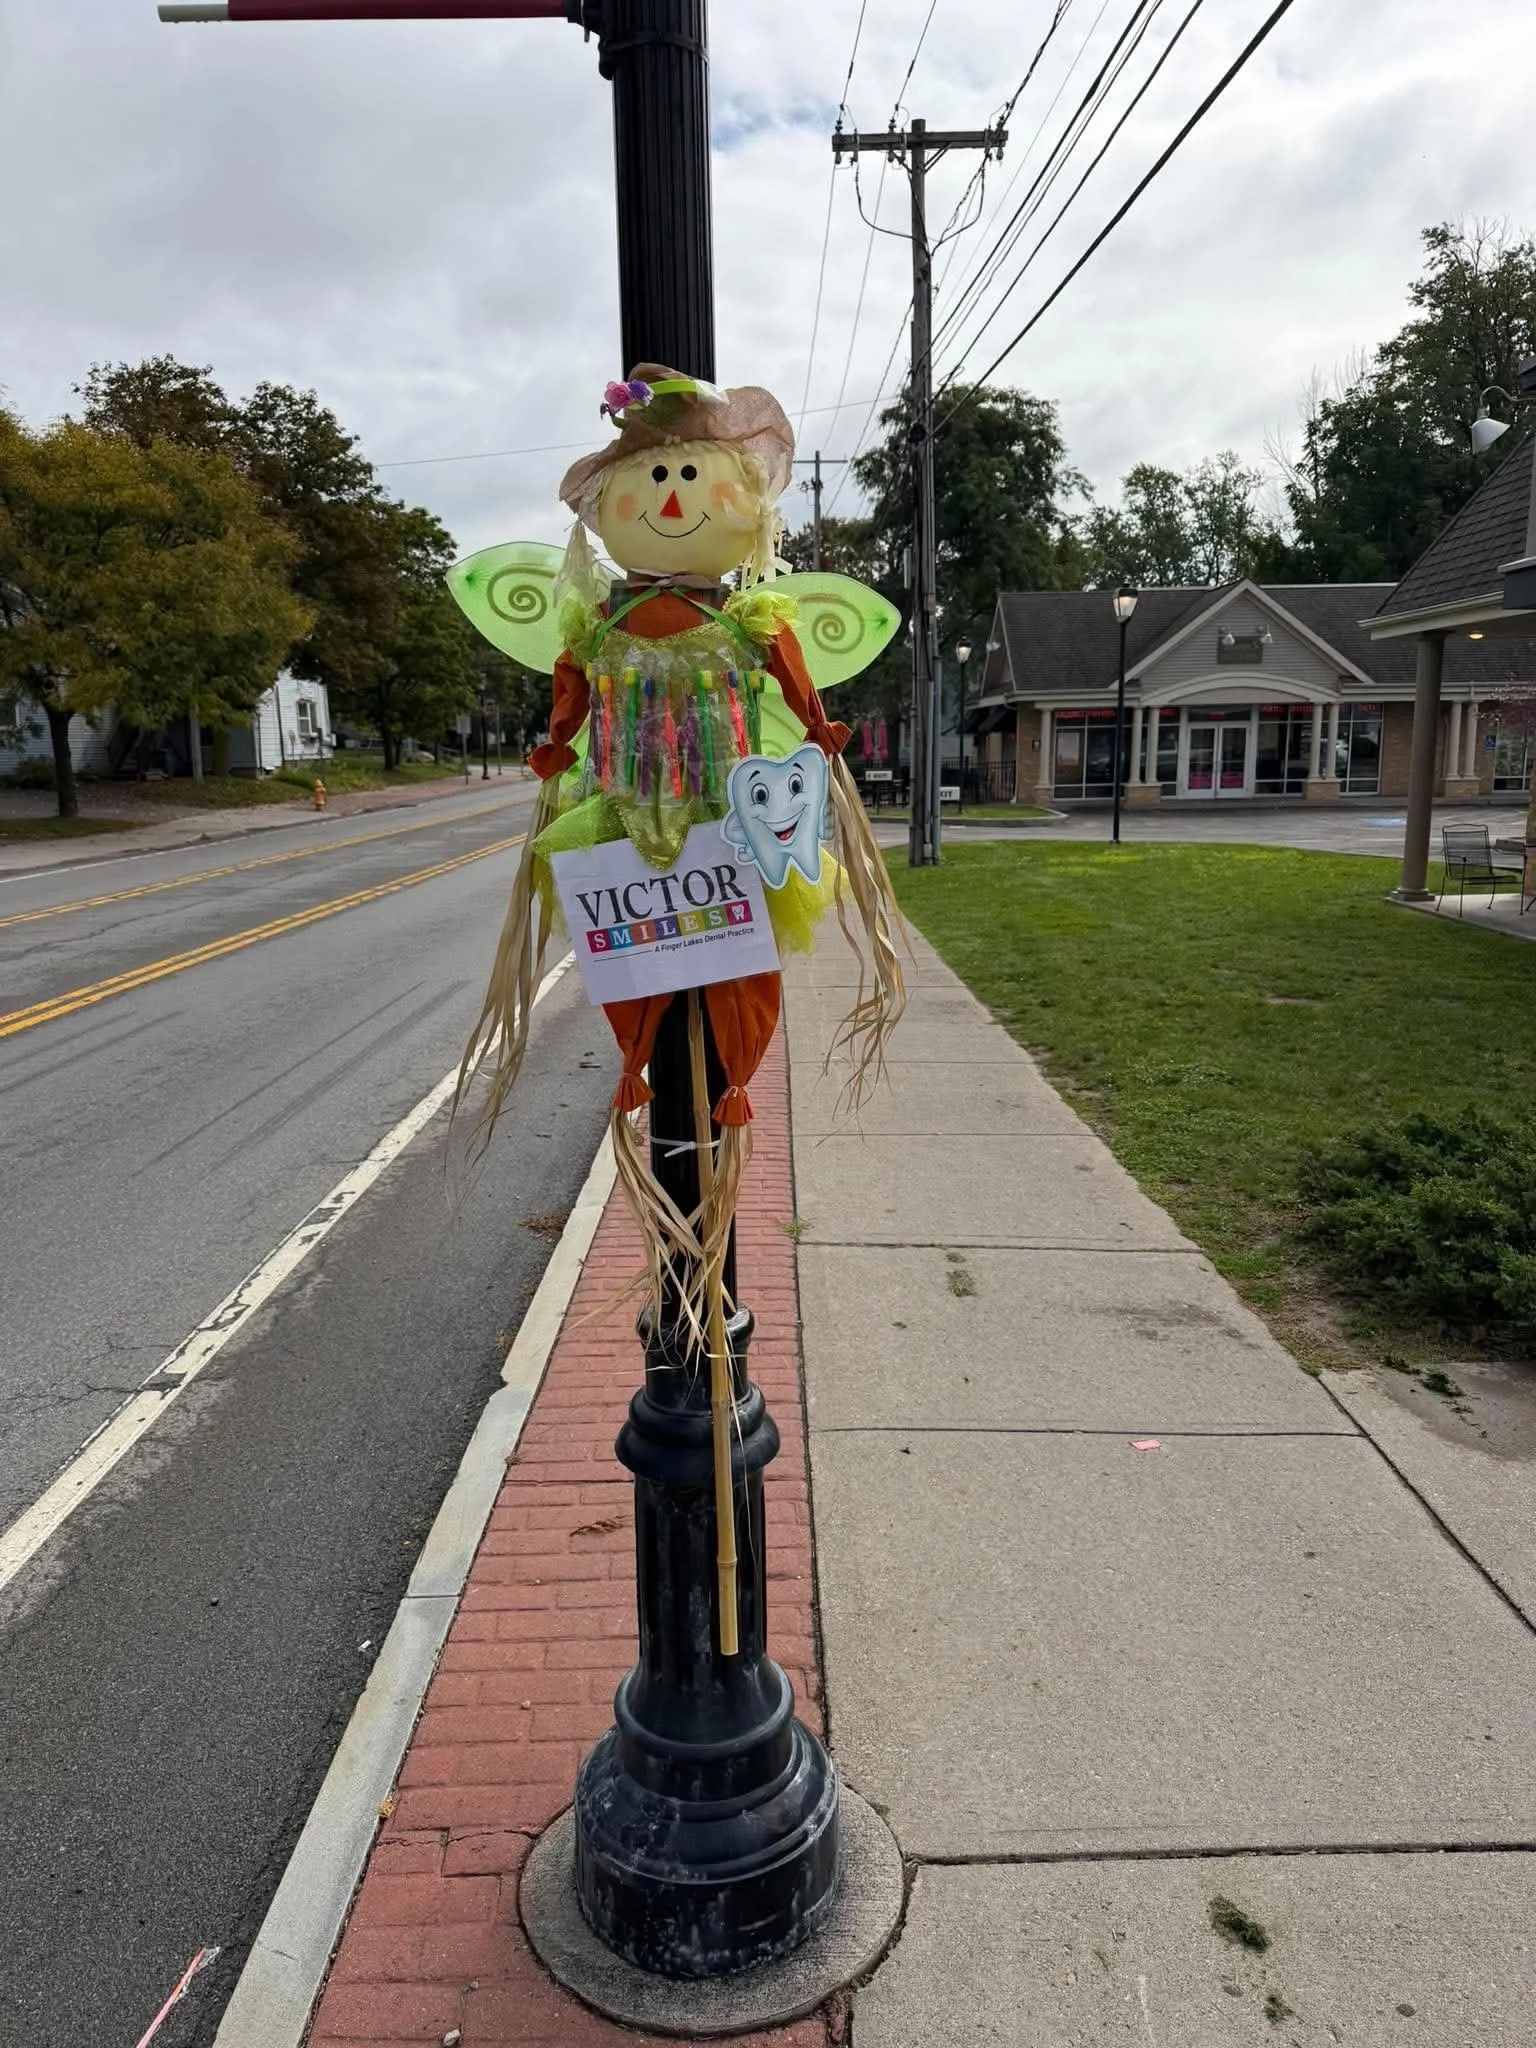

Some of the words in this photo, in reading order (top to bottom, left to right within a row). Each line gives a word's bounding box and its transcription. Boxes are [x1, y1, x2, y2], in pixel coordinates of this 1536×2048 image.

[576, 864, 747, 928] VICTOR
[593, 910, 724, 949] SMILES
[661, 940, 682, 951] Finger
[683, 935, 703, 947] Lakes
[705, 932, 726, 943] Dental
[727, 927, 755, 938] Practice
